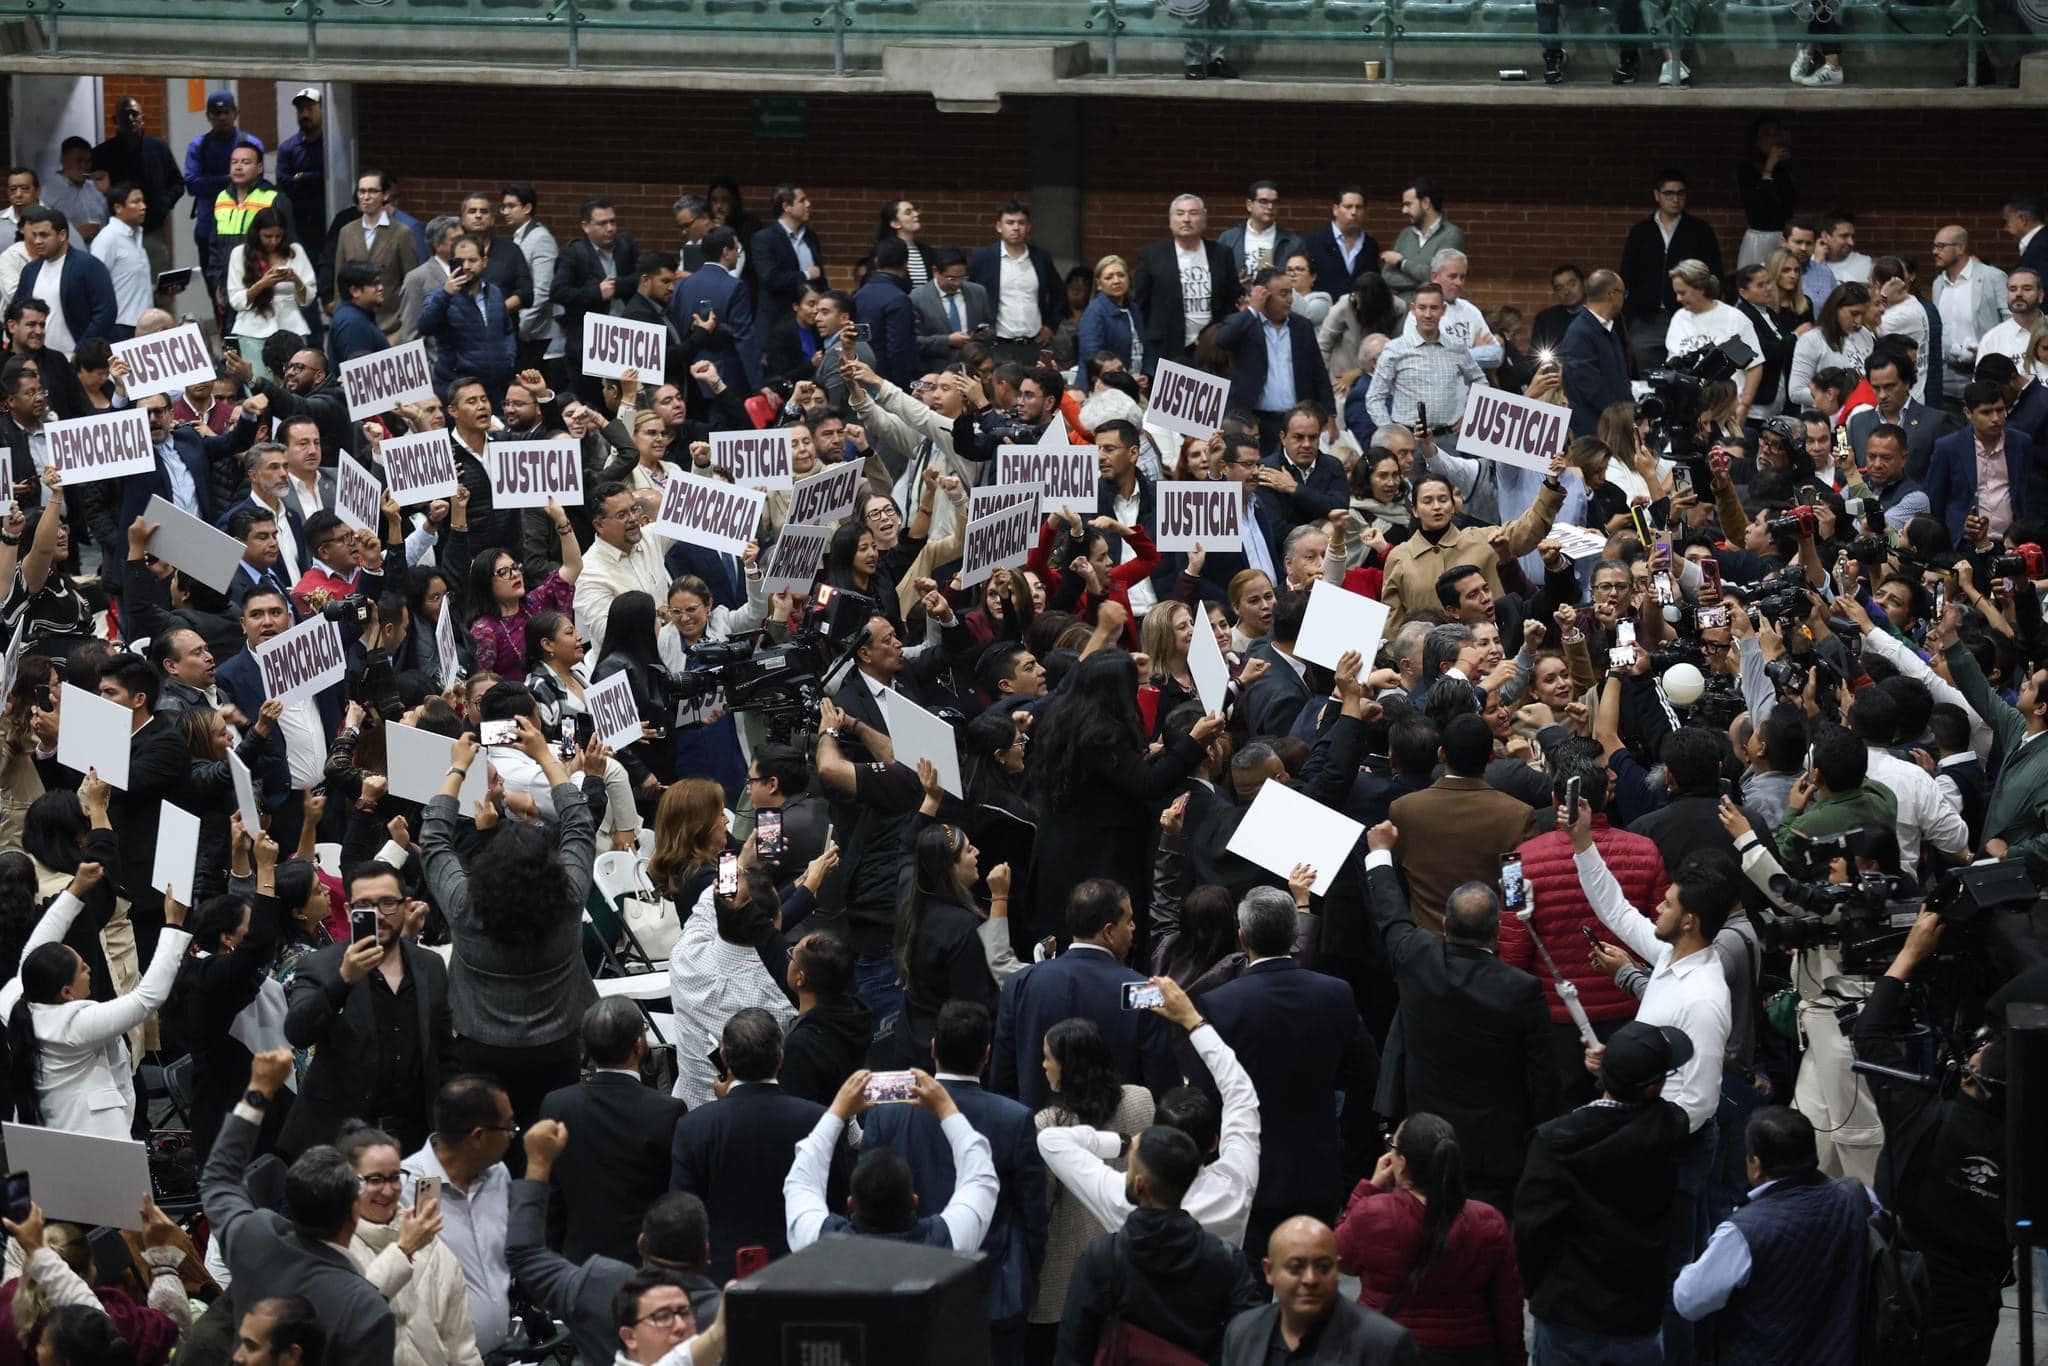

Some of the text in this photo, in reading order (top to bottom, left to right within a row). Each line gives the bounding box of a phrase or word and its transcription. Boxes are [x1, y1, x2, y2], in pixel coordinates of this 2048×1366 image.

[121, 333, 208, 387] JUSTICIA
[589, 322, 662, 371] JUSTICIA
[346, 349, 428, 408] DEMOCRACIA
[1152, 369, 1223, 429] JUSTICIA
[50, 416, 151, 472] DEMOCRACIA
[1464, 395, 1561, 459] JUSTICIA
[385, 439, 455, 492] DEMOCRACIA
[496, 450, 580, 494] JUSTICIA
[716, 437, 789, 479] JUSTICIA
[1002, 454, 1094, 498] DEMOCRACIA
[339, 461, 379, 533] DEMOCRACIA
[661, 479, 758, 542] DEMOCRACIA
[789, 468, 857, 525] JUSTICIA
[1161, 490, 1239, 537] JUSTICIA
[769, 535, 825, 580] DEMOCRACIA
[966, 510, 1028, 574] DEMOCRACIA
[262, 621, 343, 699] DEMOCRACIA
[590, 681, 638, 742] JUSTICIA
